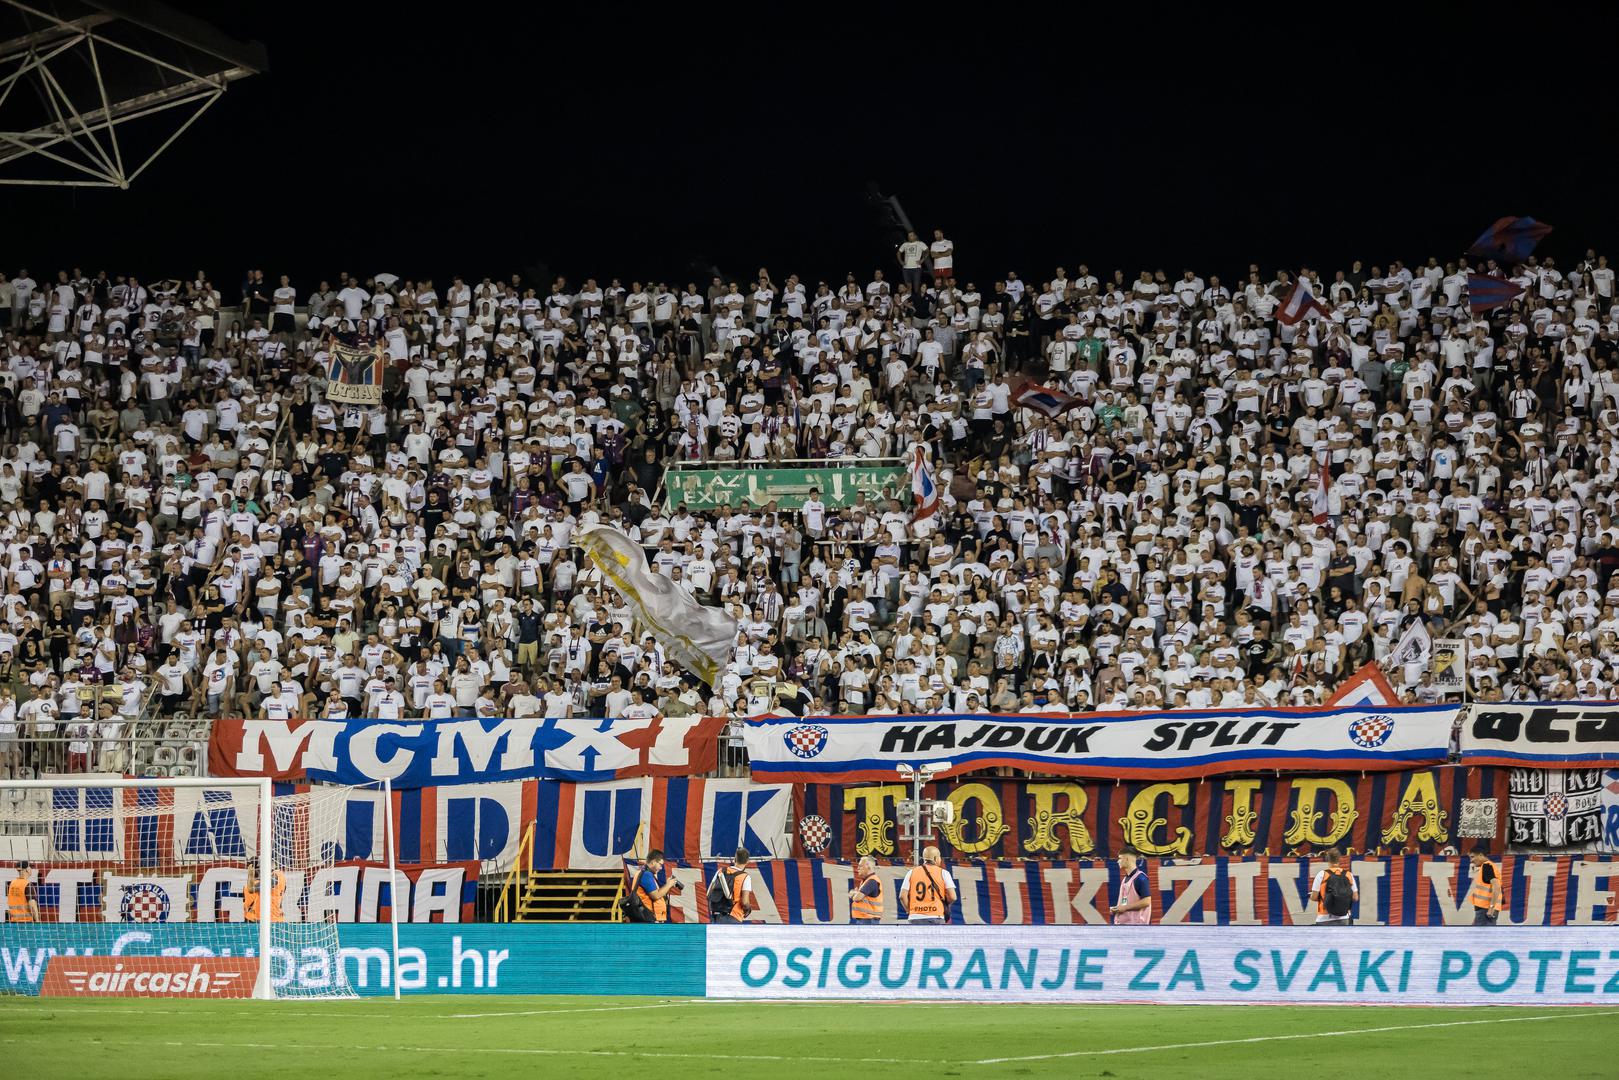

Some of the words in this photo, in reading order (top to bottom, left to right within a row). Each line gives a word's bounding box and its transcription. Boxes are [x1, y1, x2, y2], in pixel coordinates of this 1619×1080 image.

[850, 472, 912, 485] IZLA
[683, 490, 733, 504] EXIT
[879, 723, 1106, 754] HAJDUK
[1143, 718, 1301, 752] SPLIT
[1353, 737, 1384, 748] SPLIT
[236, 717, 704, 780] MCMXI
[791, 746, 821, 758] SPLIT
[843, 772, 1450, 857] TORCIDA
[1513, 801, 1539, 812] WHITE
[125, 883, 166, 900] HAJDUK
[915, 881, 936, 902] 91
[88, 963, 210, 993] aircash
[740, 948, 1108, 991] OSIGURANJE
[1129, 949, 1205, 991] ZA
[1230, 949, 1412, 992] SVAKI
